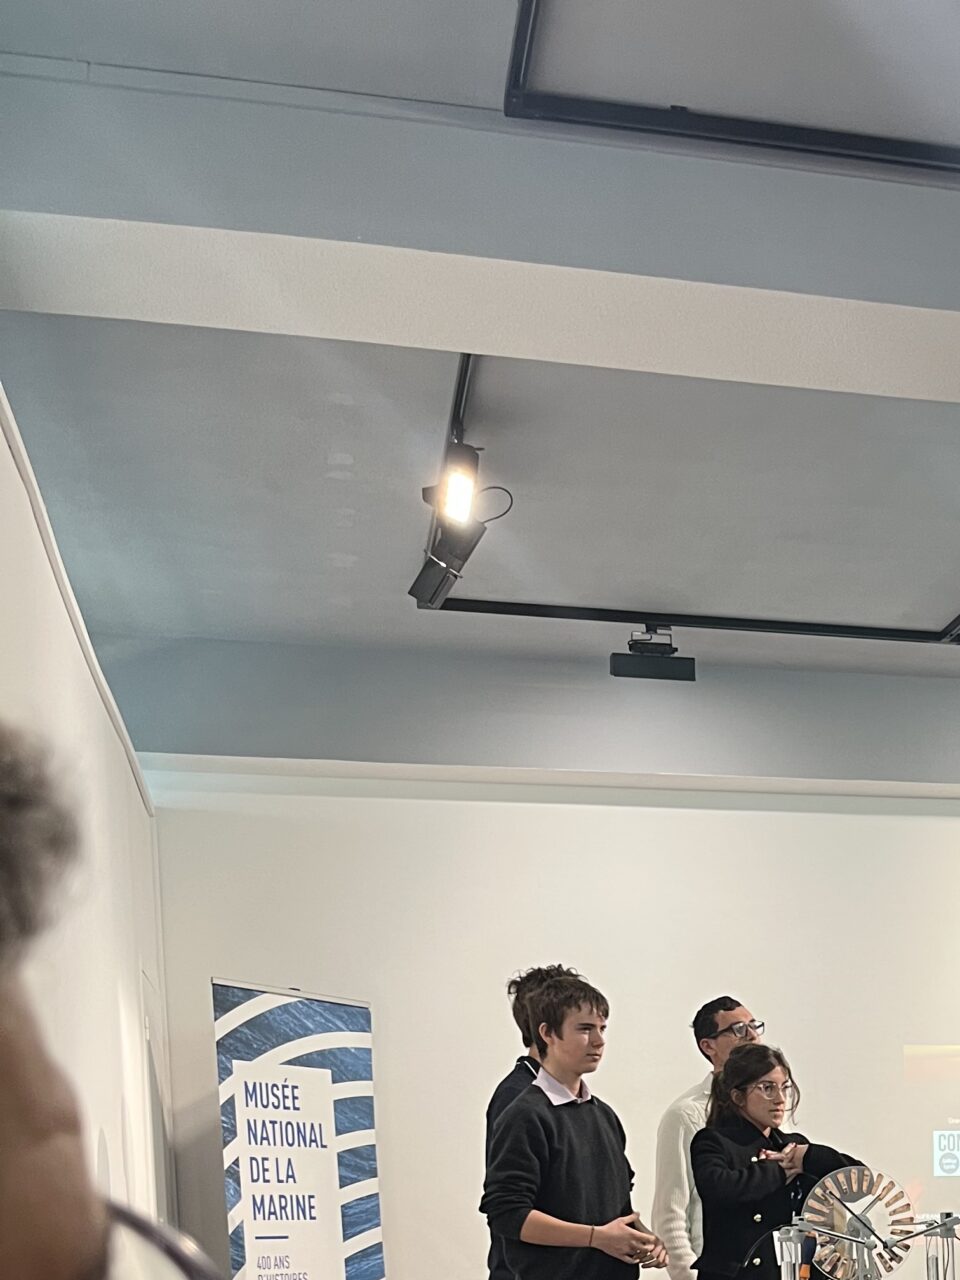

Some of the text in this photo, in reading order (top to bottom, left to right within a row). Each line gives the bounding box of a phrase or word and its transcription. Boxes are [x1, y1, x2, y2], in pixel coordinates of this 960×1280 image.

[244, 1078, 300, 1111] MUSÉE
[246, 1118, 328, 1148] NATIONAL
[249, 1156, 297, 1184] DE LA
[252, 1194, 317, 1221] MARINE
[256, 1255, 290, 1270] 400 ANS
